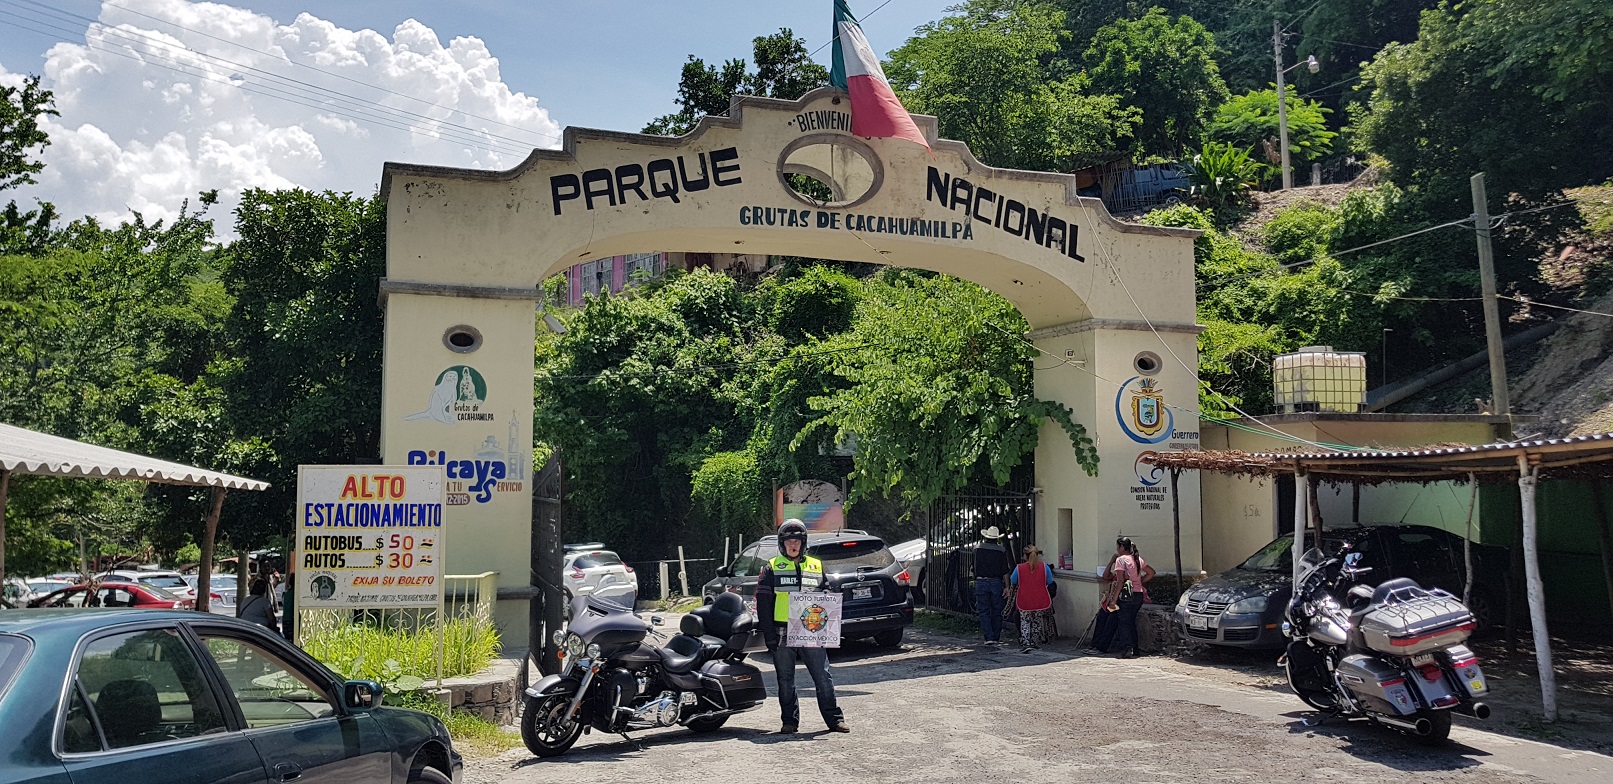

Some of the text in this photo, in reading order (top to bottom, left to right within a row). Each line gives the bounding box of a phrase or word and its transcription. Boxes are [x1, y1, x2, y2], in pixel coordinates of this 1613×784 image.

[550, 147, 1085, 263] PARQUE NACIONAL
[739, 205, 974, 241] GRUTAS DE CACAHUAMILPA
[1171, 428, 1199, 440] Guerrero
[341, 475, 406, 499] ALTO
[453, 482, 462, 492] TU
[304, 503, 442, 528] ESTACIONAMIENTO
[389, 553, 414, 569] 30
[353, 575, 435, 585] EXIJA SU BOLETO
